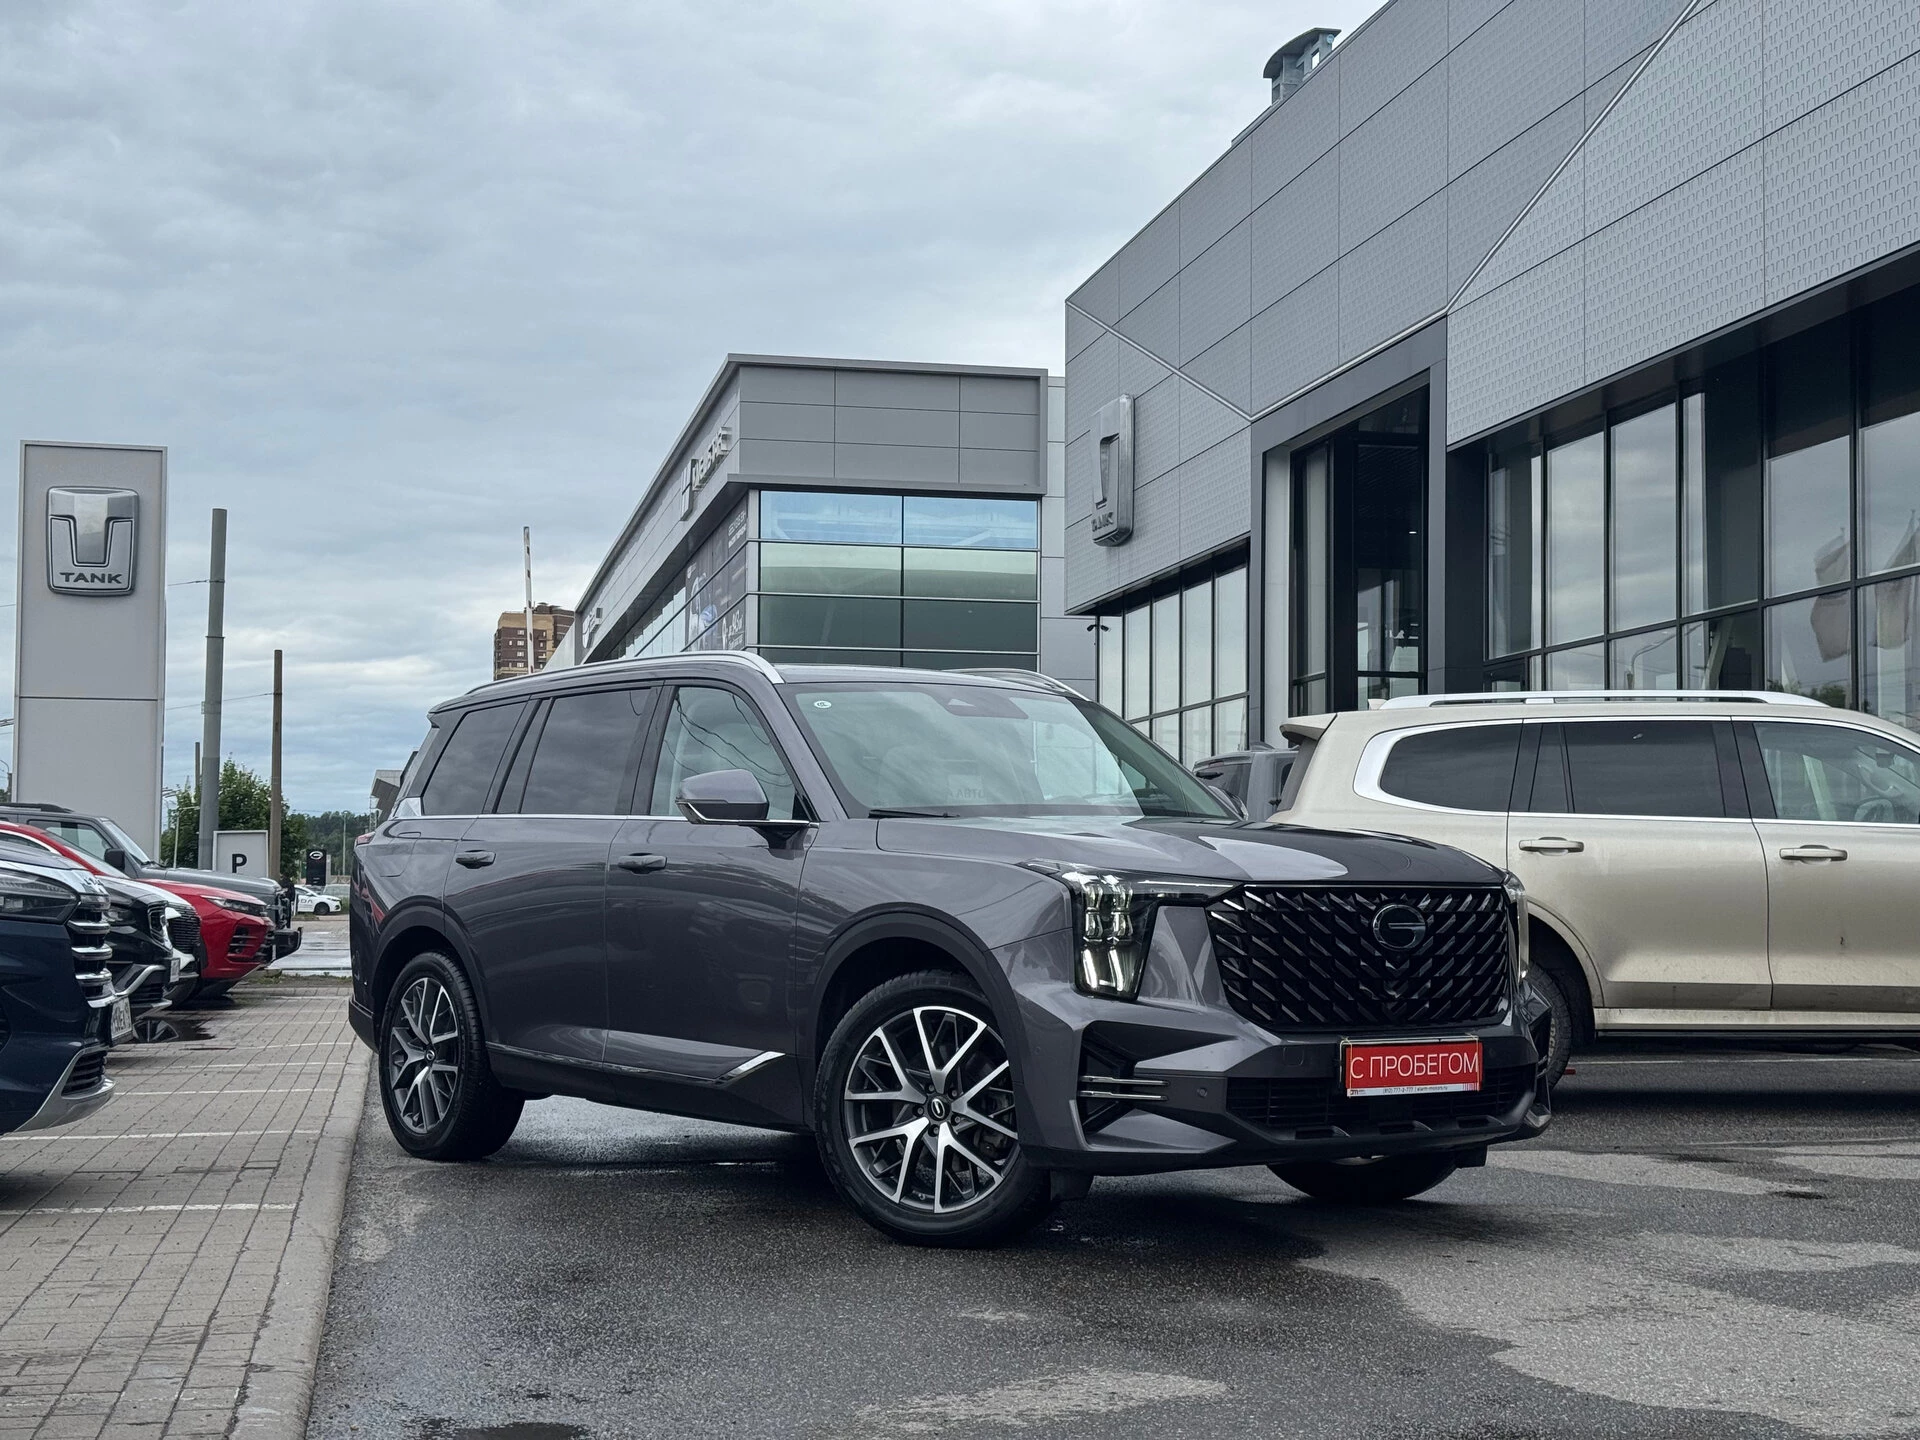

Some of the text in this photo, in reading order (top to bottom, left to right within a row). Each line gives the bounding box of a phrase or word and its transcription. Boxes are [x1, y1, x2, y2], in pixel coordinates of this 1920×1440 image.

[59, 572, 122, 584] TANK
[232, 853, 247, 873] P
[1351, 1051, 1478, 1079] С ПРОБЕГОМ
